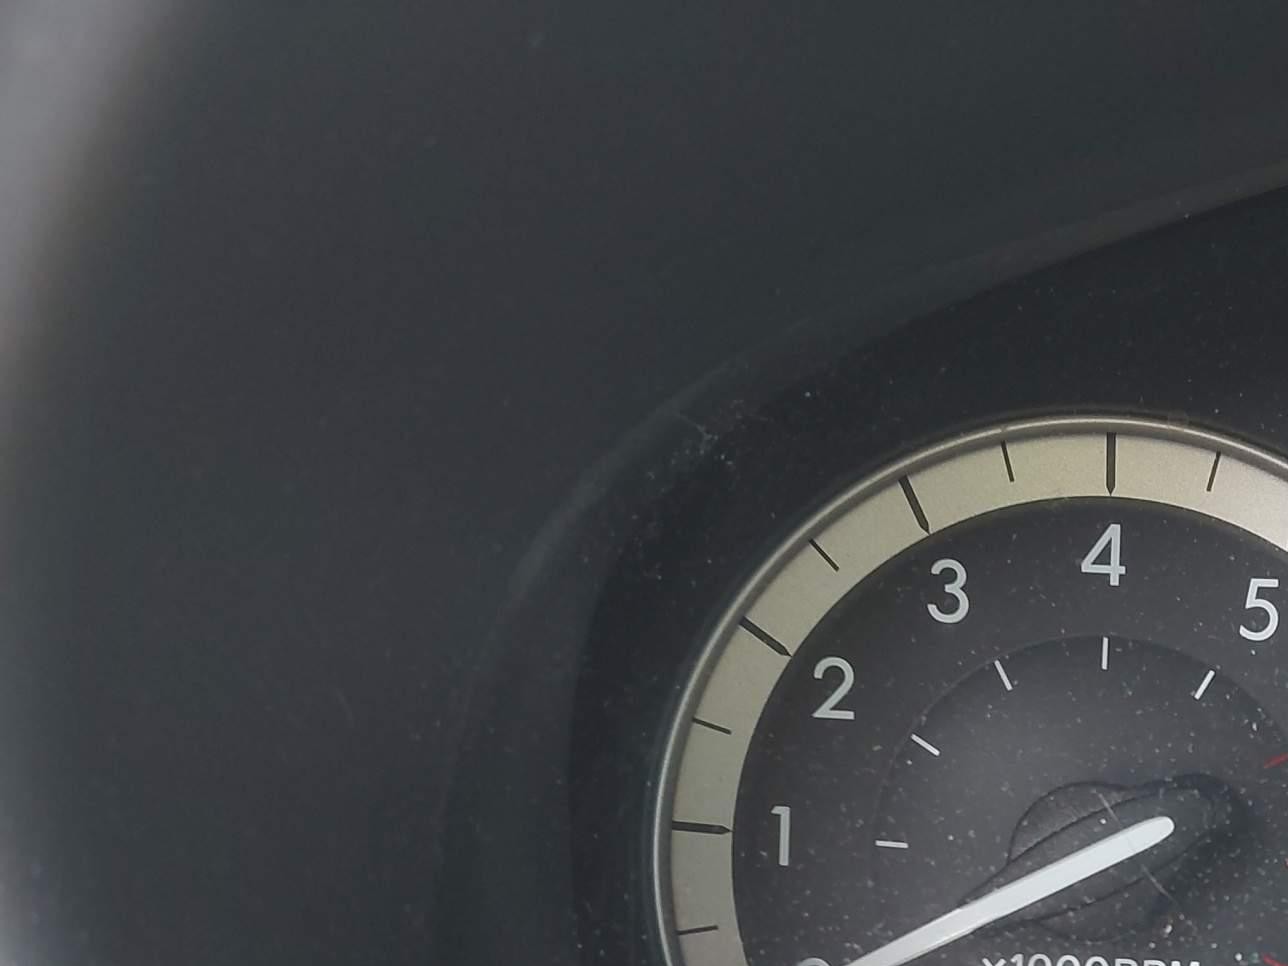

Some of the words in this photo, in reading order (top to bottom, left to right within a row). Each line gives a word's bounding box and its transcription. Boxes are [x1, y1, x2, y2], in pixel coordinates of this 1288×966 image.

[1081, 524, 1125, 586] 4
[928, 559, 969, 623] 3
[1240, 578, 1278, 641] 5
[813, 657, 854, 719] 2
[770, 806, 791, 866] 1
